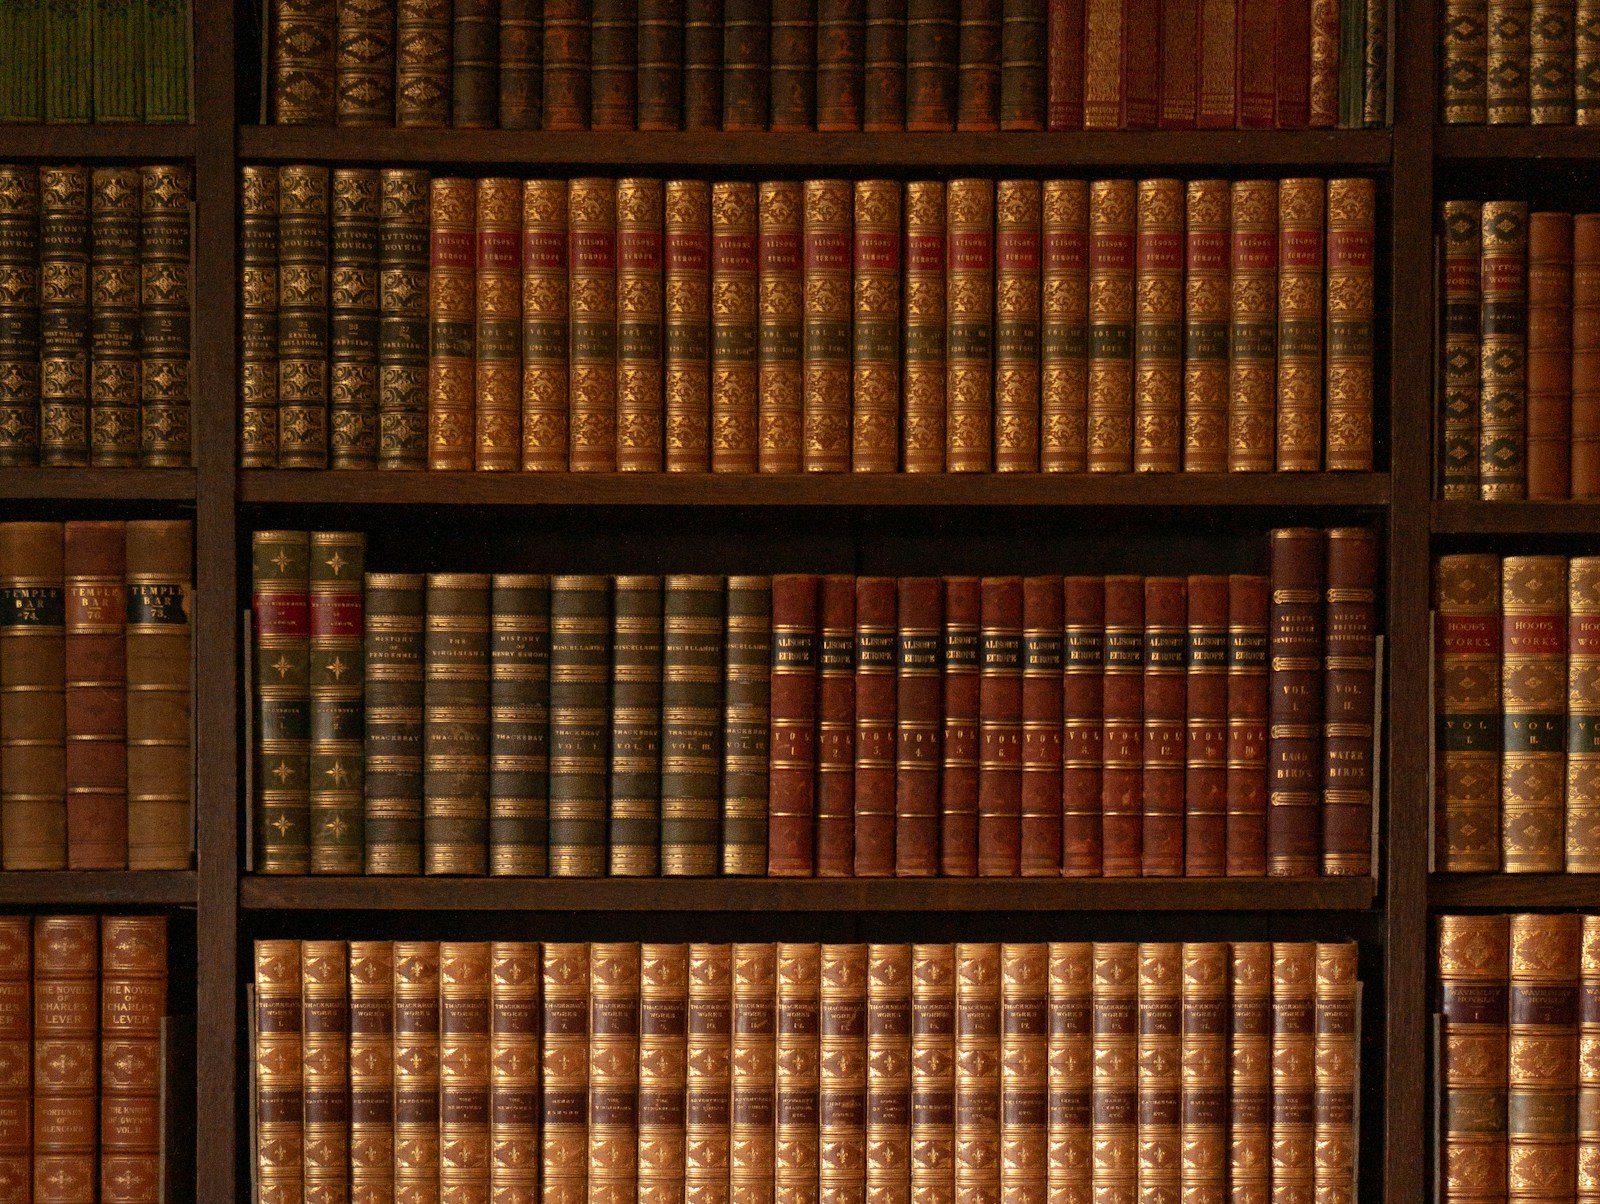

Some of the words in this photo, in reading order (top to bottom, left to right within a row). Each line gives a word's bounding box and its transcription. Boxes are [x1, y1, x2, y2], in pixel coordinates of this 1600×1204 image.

[4, 589, 57, 599] TEMPLE
[71, 588, 120, 598] TEMPLE
[16, 599, 45, 609] BAR
[82, 598, 109, 608] BAR
[143, 596, 172, 606] BAR
[1283, 686, 1309, 695] VOL.
[1336, 685, 1362, 693] VOL.
[1329, 752, 1363, 760] WATER
[46, 1016, 82, 1024] LEVER
[112, 1016, 150, 1024] LEVER
